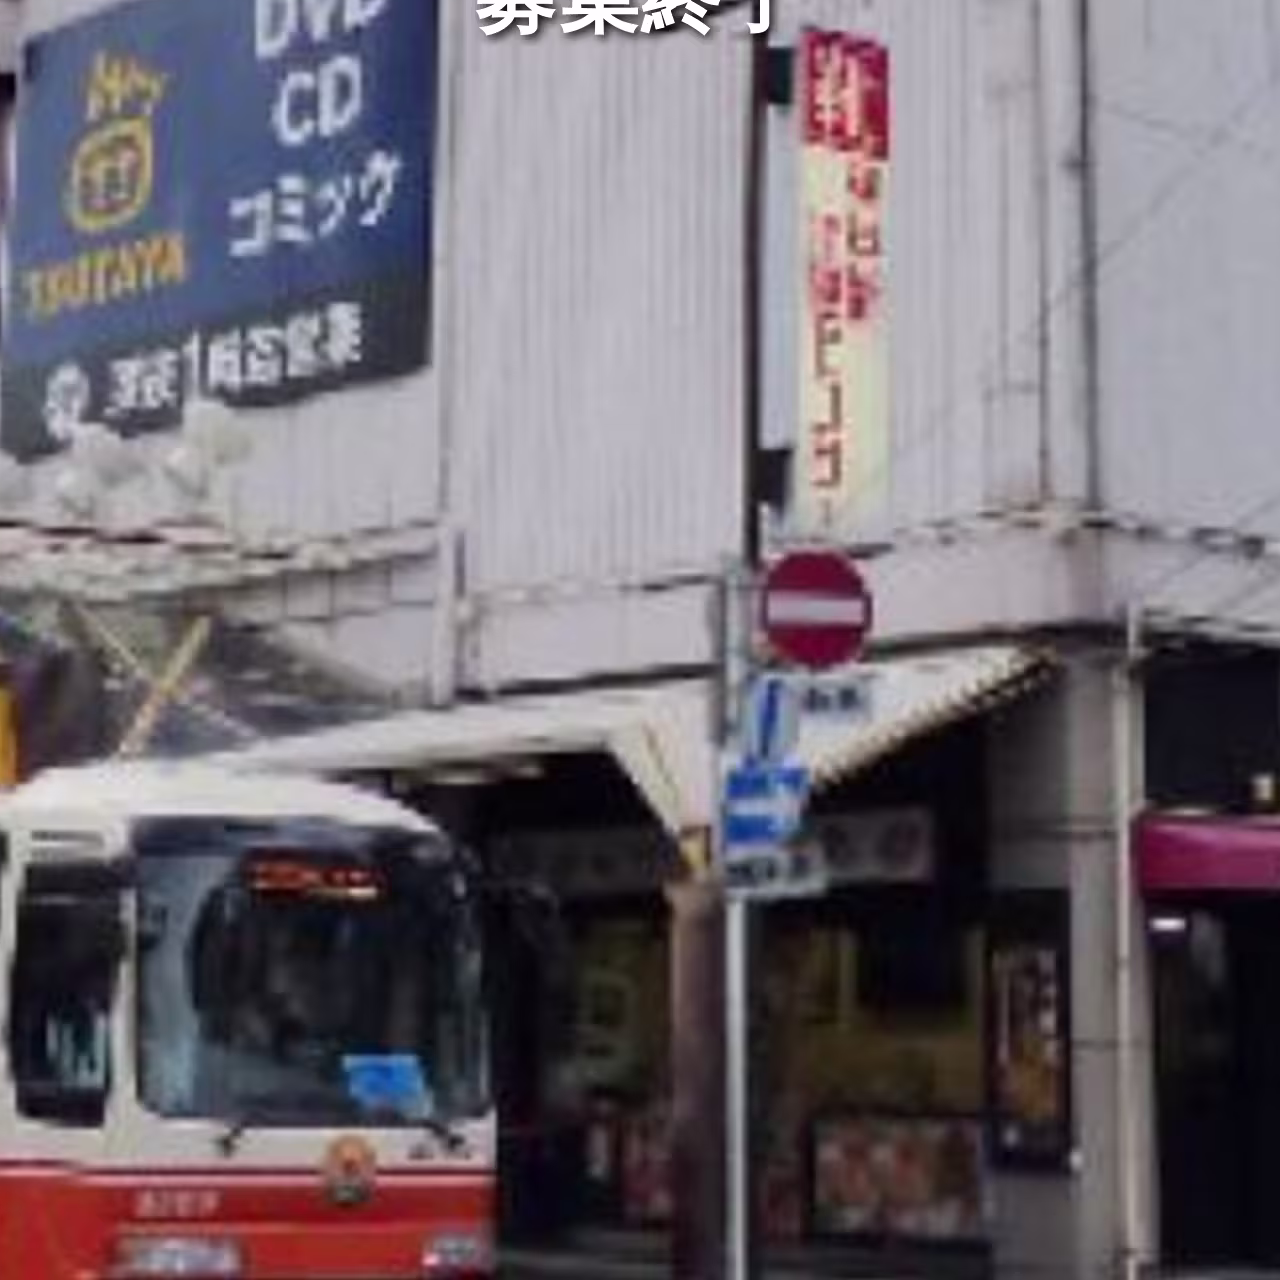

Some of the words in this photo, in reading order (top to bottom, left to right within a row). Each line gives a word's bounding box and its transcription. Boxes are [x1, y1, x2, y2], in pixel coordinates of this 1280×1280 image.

[272, 54, 363, 147] CD
[227, 149, 404, 257] コミック
[25, 232, 187, 324] TSUTAYA
